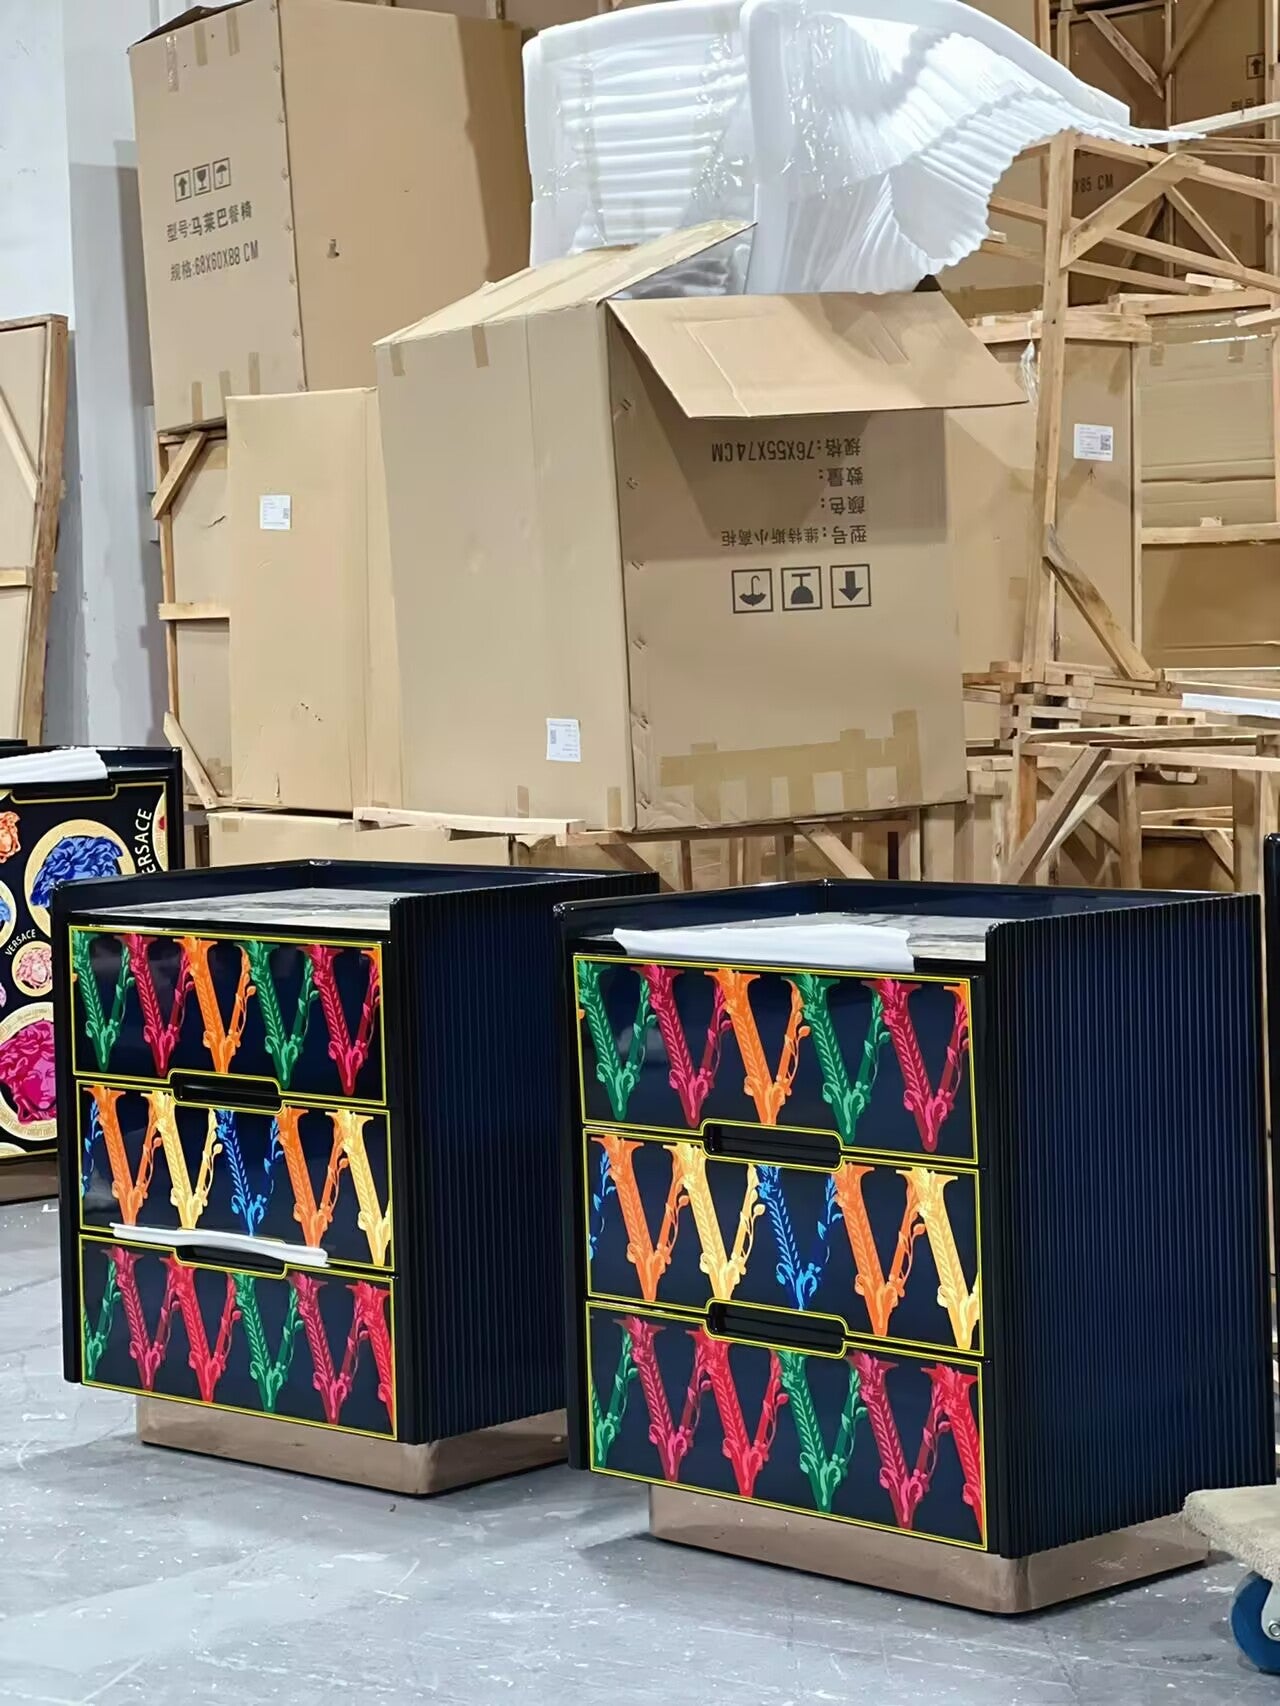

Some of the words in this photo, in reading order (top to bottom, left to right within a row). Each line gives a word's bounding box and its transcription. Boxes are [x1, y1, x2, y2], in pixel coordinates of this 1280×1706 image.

[244, 240, 259, 263] CM
[134, 808, 156, 874] ERSACE
[5, 928, 36, 956] VERSACE
